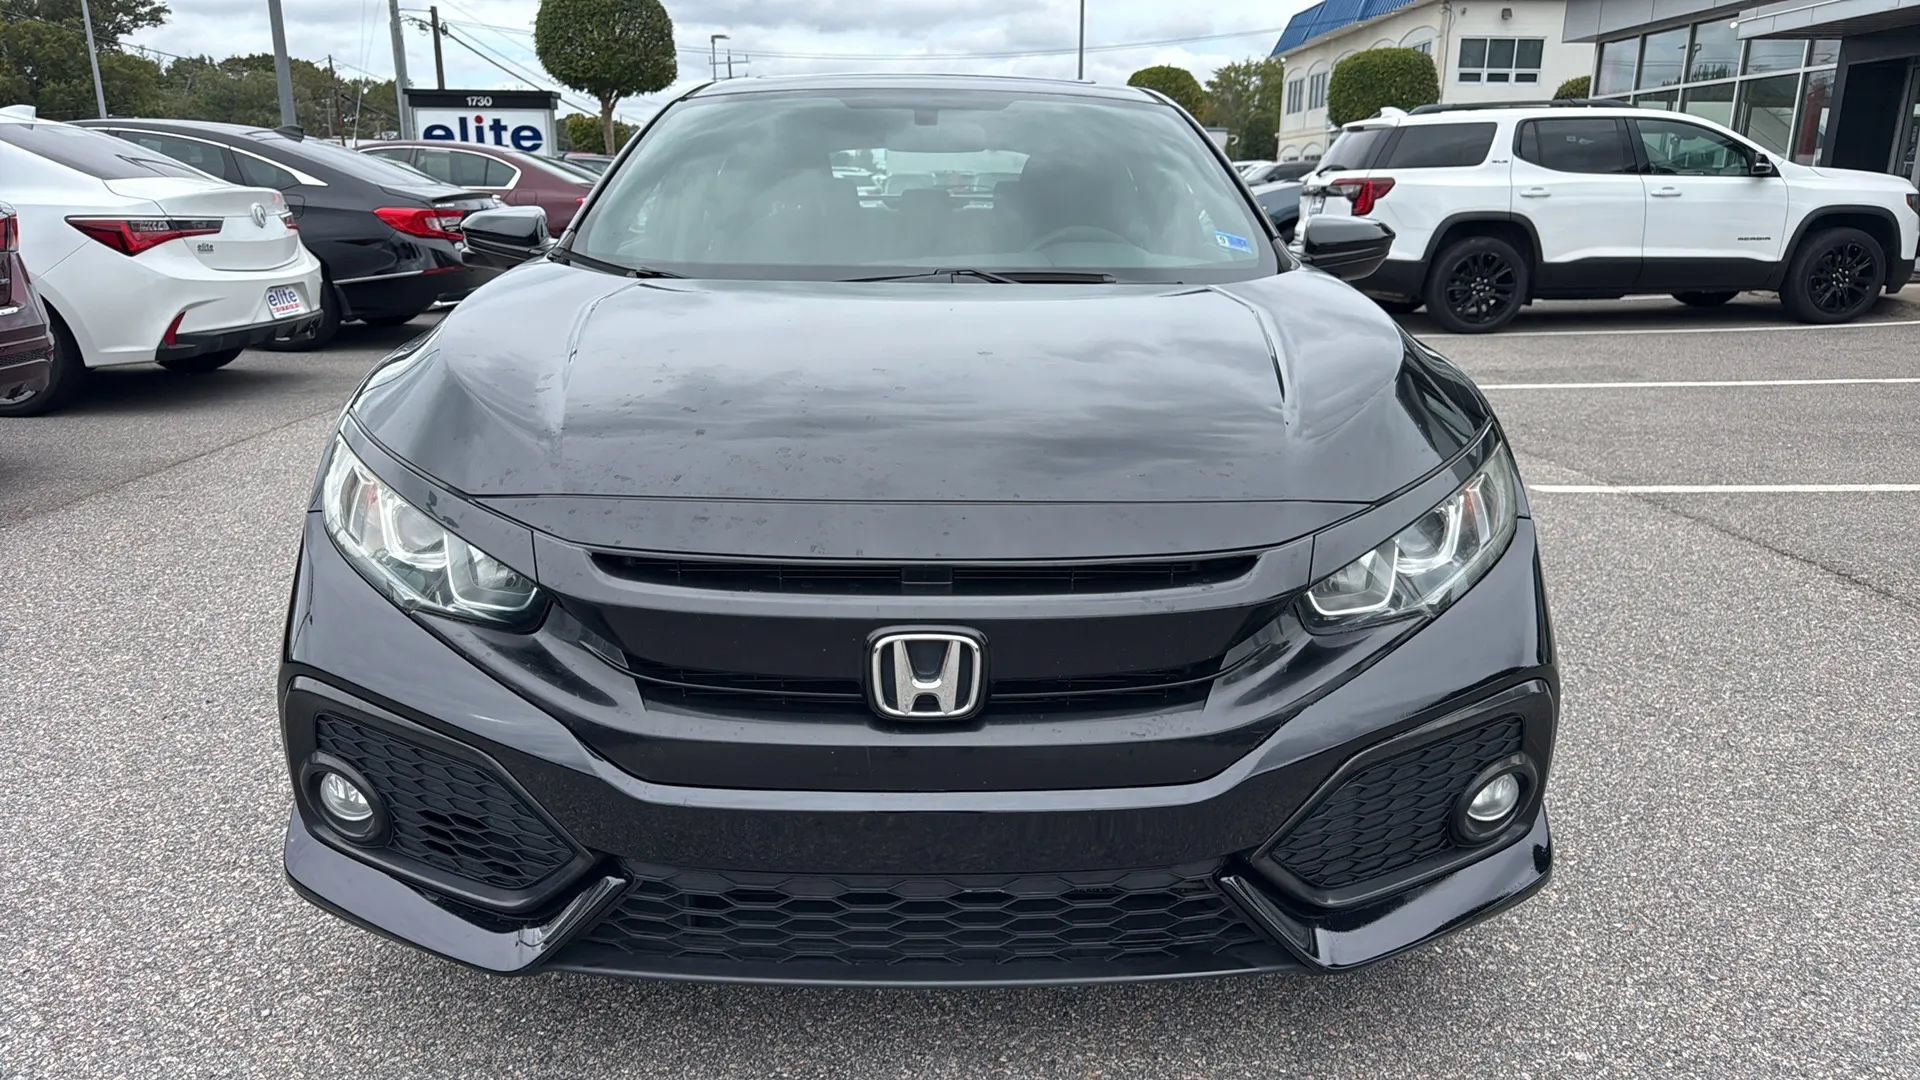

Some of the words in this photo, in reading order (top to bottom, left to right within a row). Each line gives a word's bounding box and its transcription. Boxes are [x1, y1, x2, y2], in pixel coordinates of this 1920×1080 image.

[466, 96, 493, 107] 1730
[423, 114, 543, 152] elite
[268, 289, 298, 307] elite
